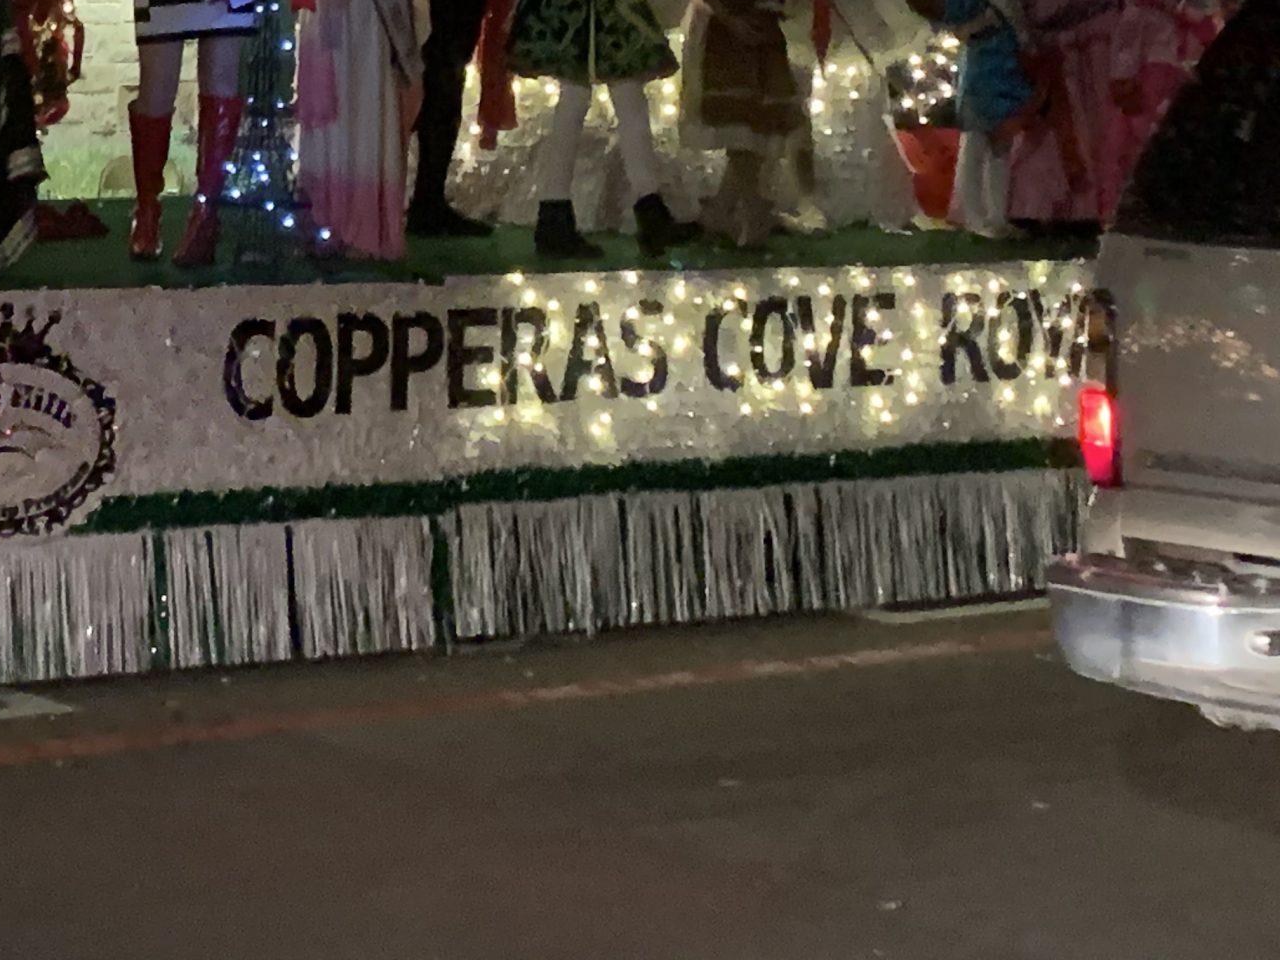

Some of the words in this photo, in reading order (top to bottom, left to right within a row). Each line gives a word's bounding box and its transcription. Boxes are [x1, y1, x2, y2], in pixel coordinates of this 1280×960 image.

[222, 296, 669, 421] COPPERAS
[703, 291, 895, 390] COVE
[10, 383, 78, 429] Hills
